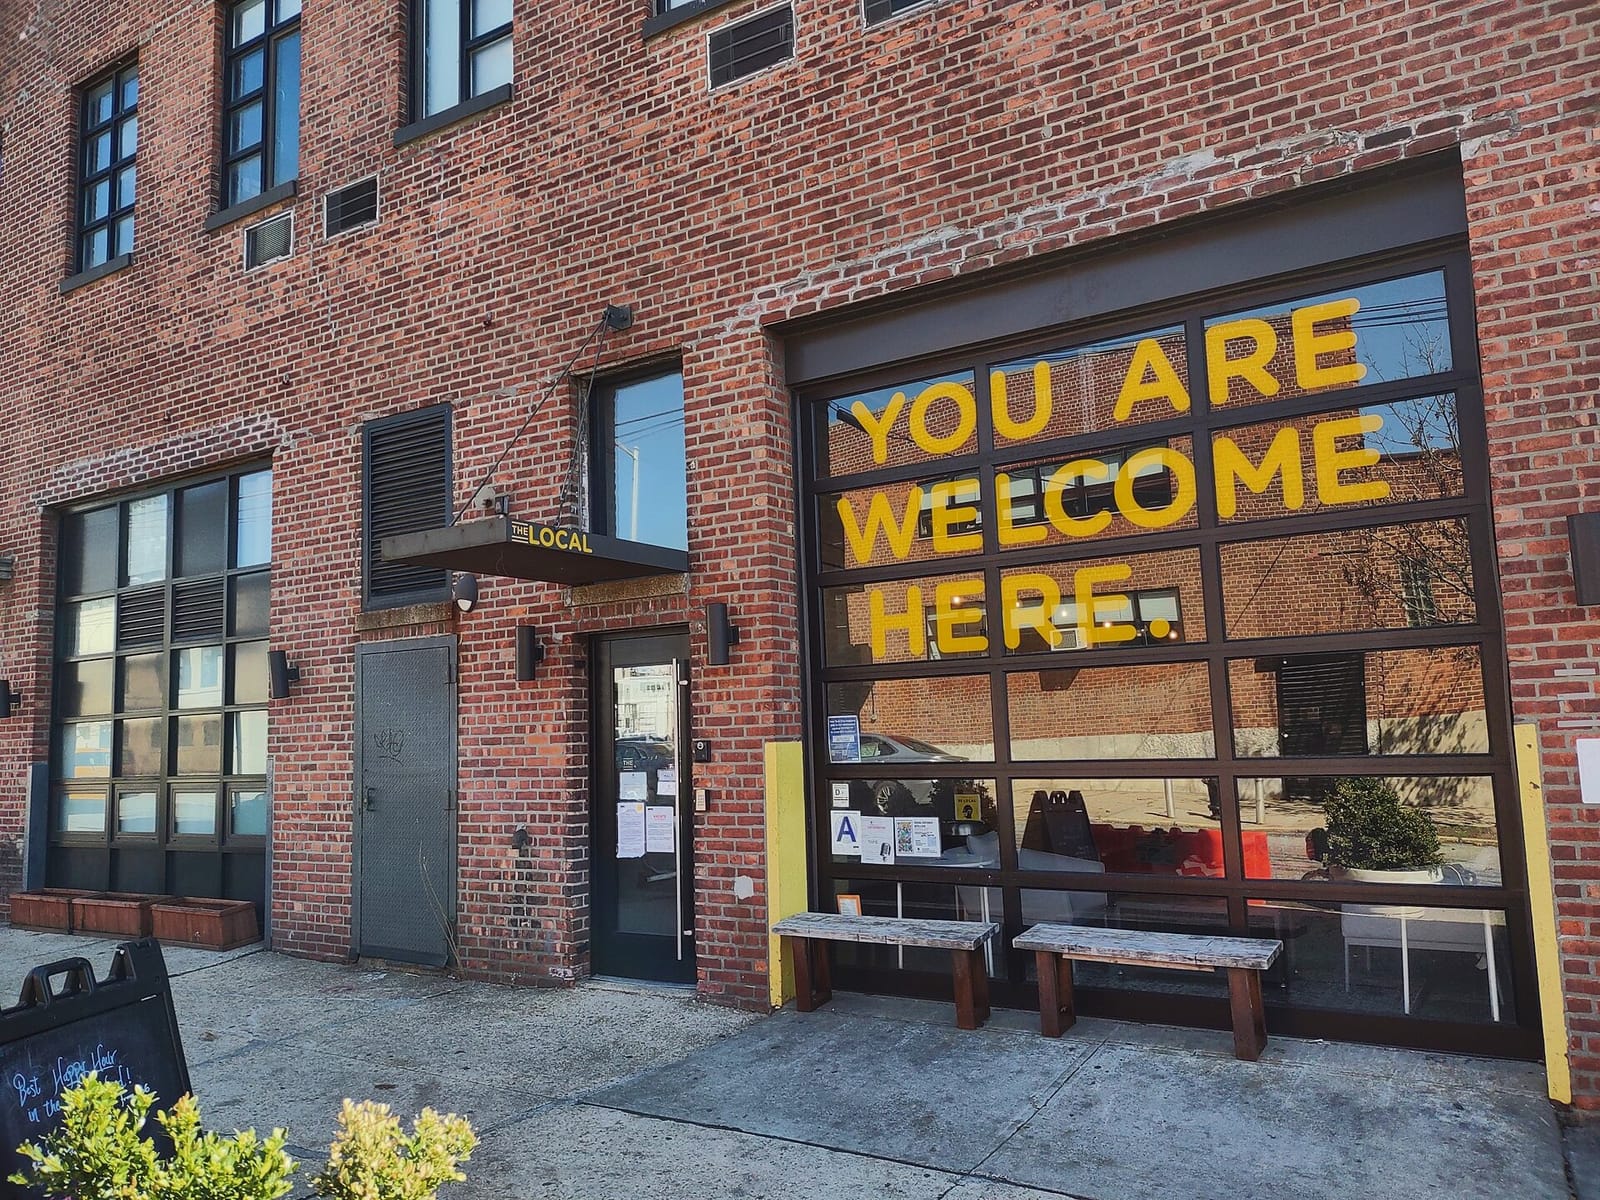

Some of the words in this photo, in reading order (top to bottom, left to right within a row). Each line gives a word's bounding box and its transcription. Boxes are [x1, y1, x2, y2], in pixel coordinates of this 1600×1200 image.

[851, 361, 1052, 464] YOU
[1113, 298, 1368, 422] ARE
[837, 415, 1391, 565] WELCOME
[512, 525, 528, 537] THE
[528, 525, 593, 553] LOCAL
[870, 564, 1171, 659] HERE.
[836, 816, 857, 843] A
[13, 1073, 41, 1107] Best
[53, 1057, 89, 1096] Happy
[91, 1044, 118, 1073] Hour
[27, 1108, 40, 1122] in
[43, 1099, 61, 1117] the
